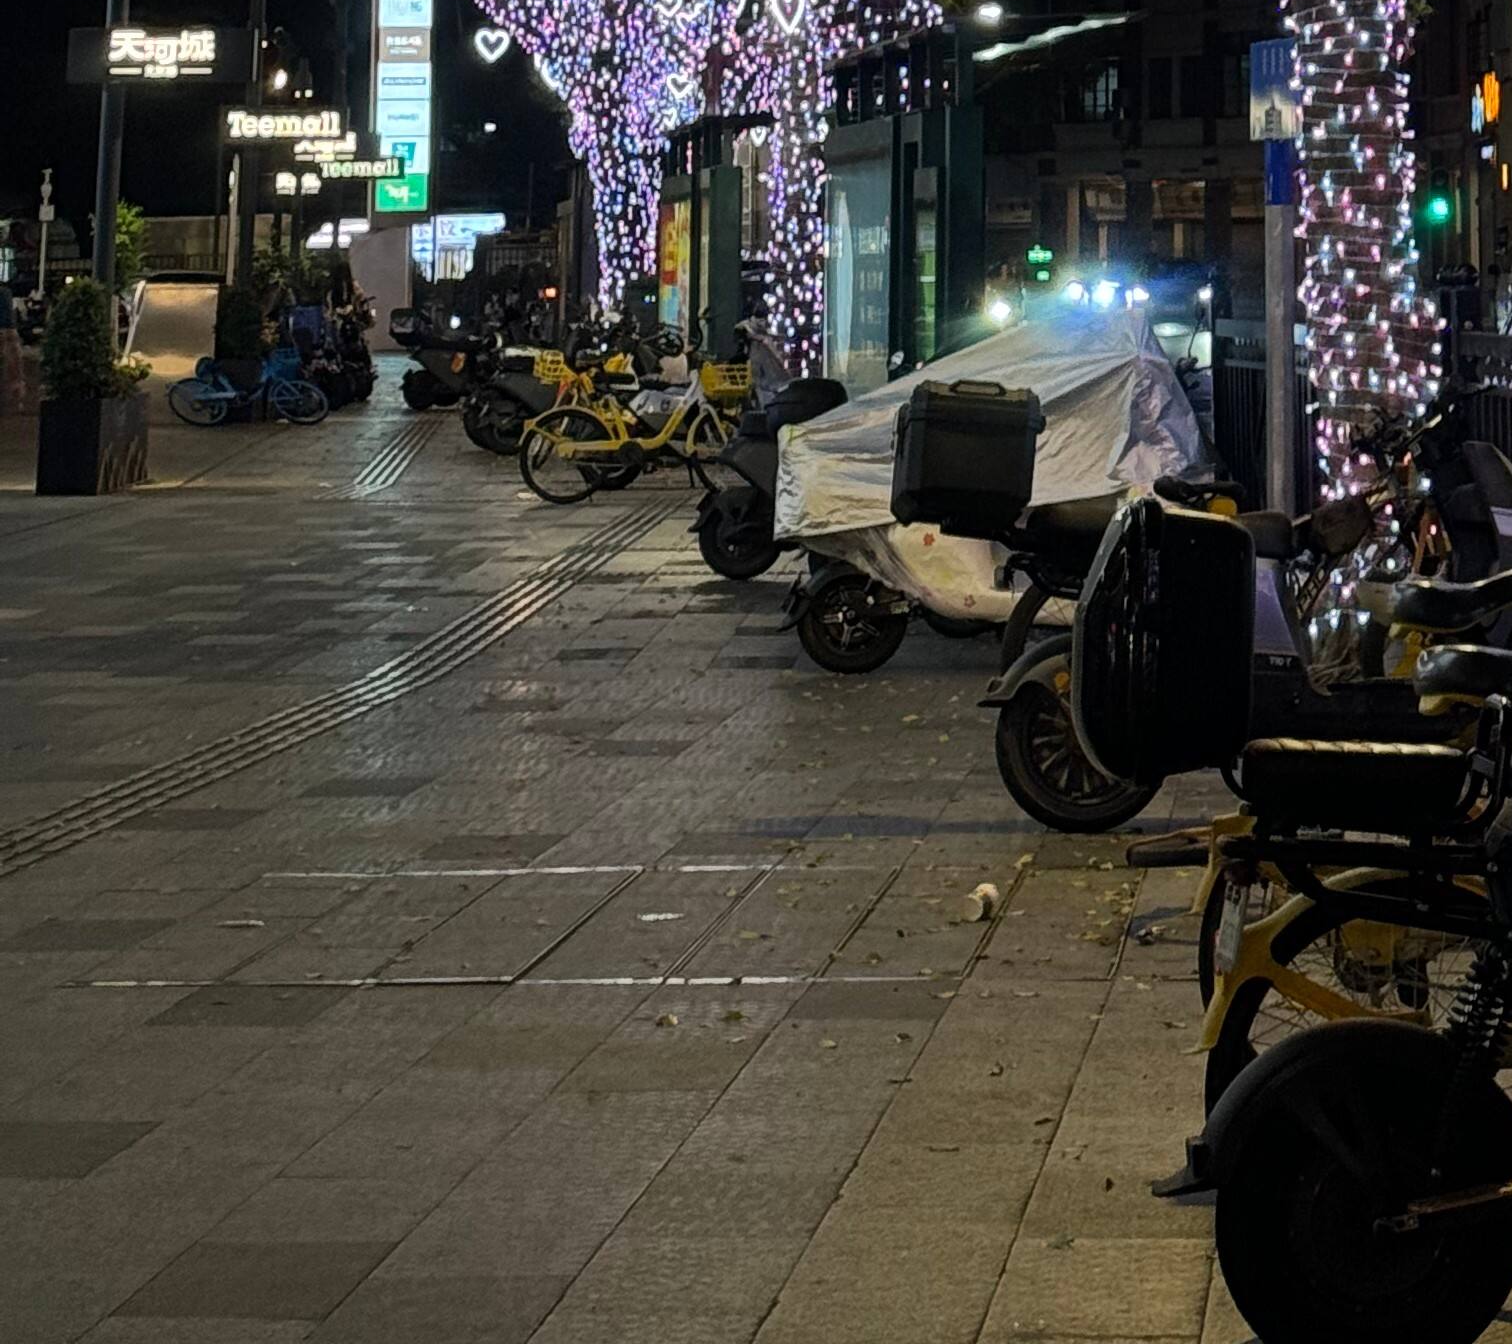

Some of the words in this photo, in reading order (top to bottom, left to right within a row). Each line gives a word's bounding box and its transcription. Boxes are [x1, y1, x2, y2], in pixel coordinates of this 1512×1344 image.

[108, 29, 216, 65] 天河城
[228, 110, 341, 139] Teemall
[320, 159, 401, 178] Teemall
